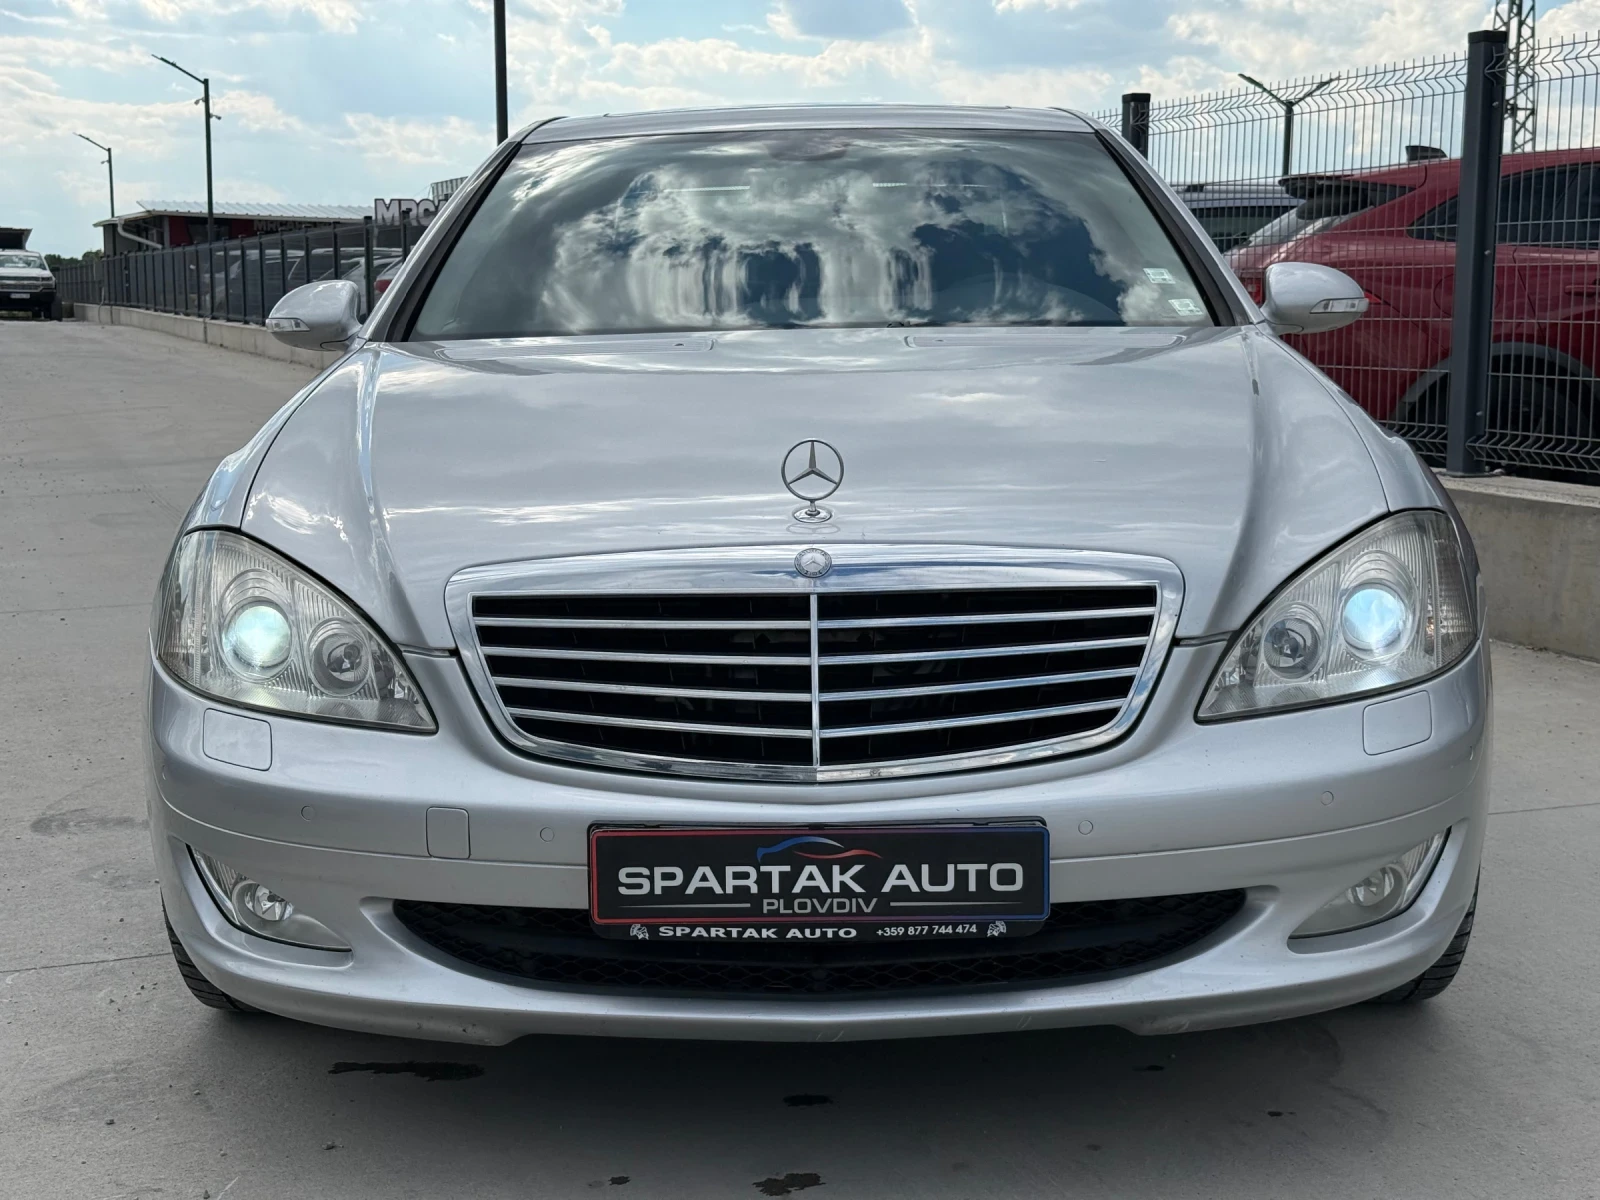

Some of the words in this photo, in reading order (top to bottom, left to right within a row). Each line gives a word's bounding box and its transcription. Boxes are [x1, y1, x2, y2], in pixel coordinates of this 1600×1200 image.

[617, 865, 866, 896] SPARTAK
[881, 862, 1023, 892] AUTO
[762, 898, 878, 914] PLOVDIV
[658, 926, 779, 939] SPARTAK
[785, 928, 857, 939] AUTO
[876, 927, 905, 938] +359
[907, 926, 927, 937] 877
[932, 925, 953, 936] 744
[956, 924, 977, 935] 474
